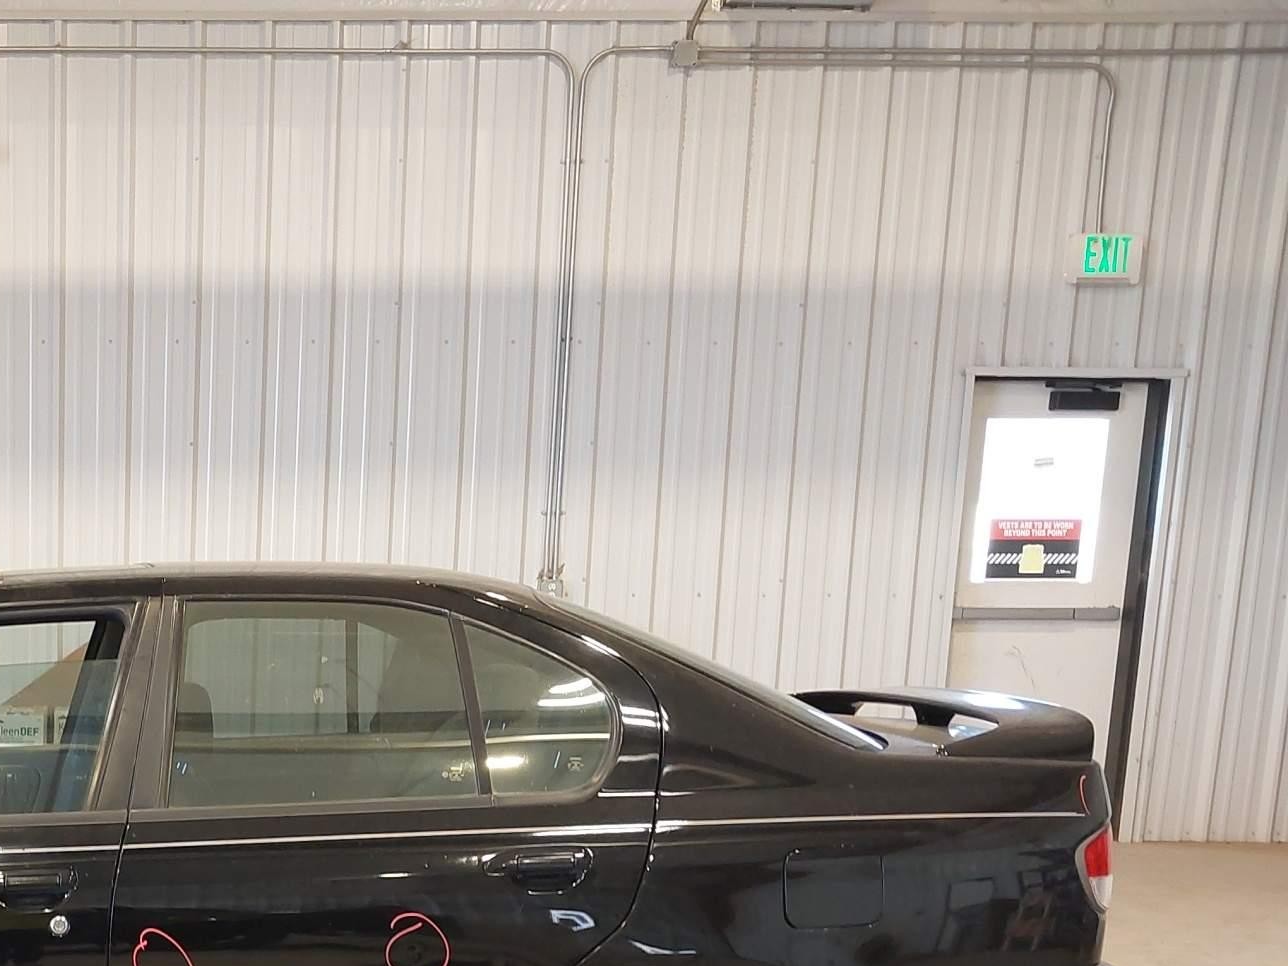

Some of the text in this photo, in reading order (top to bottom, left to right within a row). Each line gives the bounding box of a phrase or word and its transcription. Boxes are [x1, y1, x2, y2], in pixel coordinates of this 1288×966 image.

[1084, 236, 1133, 273] EXIT
[1033, 521, 1043, 529] TO
[1003, 529, 1067, 537] BEYOND THIS POINT
